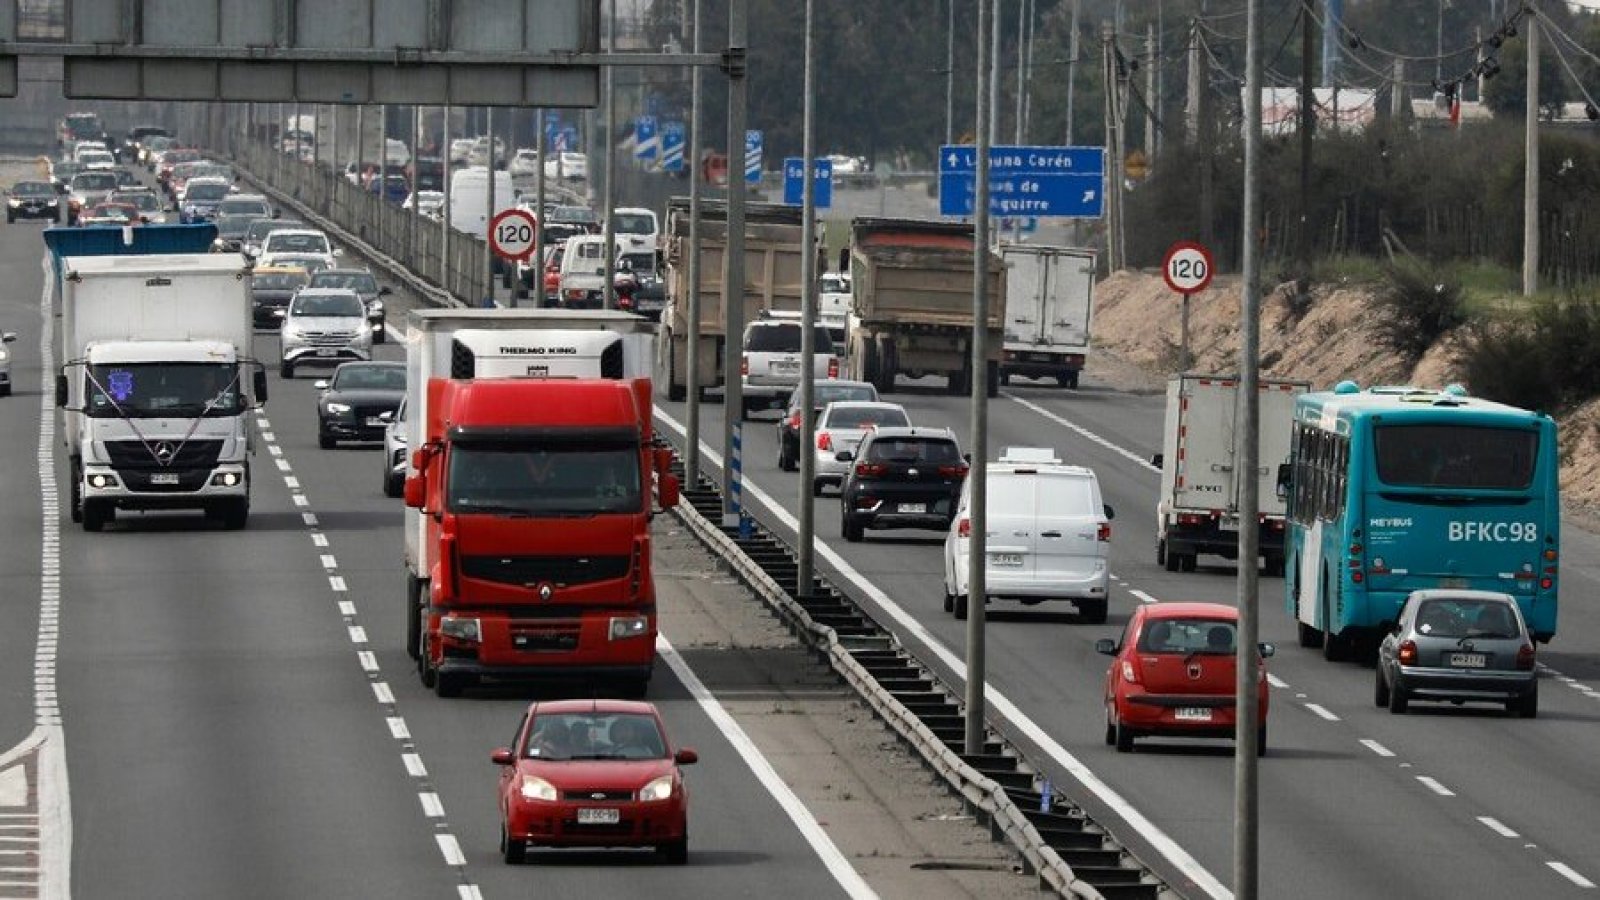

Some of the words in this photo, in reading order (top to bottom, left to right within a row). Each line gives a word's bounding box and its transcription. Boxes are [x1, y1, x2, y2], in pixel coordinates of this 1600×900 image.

[1029, 153, 1073, 167] Carén
[1020, 181, 1039, 193] de
[498, 225, 531, 243] 120
[1172, 259, 1206, 279] 120
[499, 346, 545, 354] THERMO
[548, 346, 577, 354] KING
[1448, 520, 1537, 542] BFKC98
